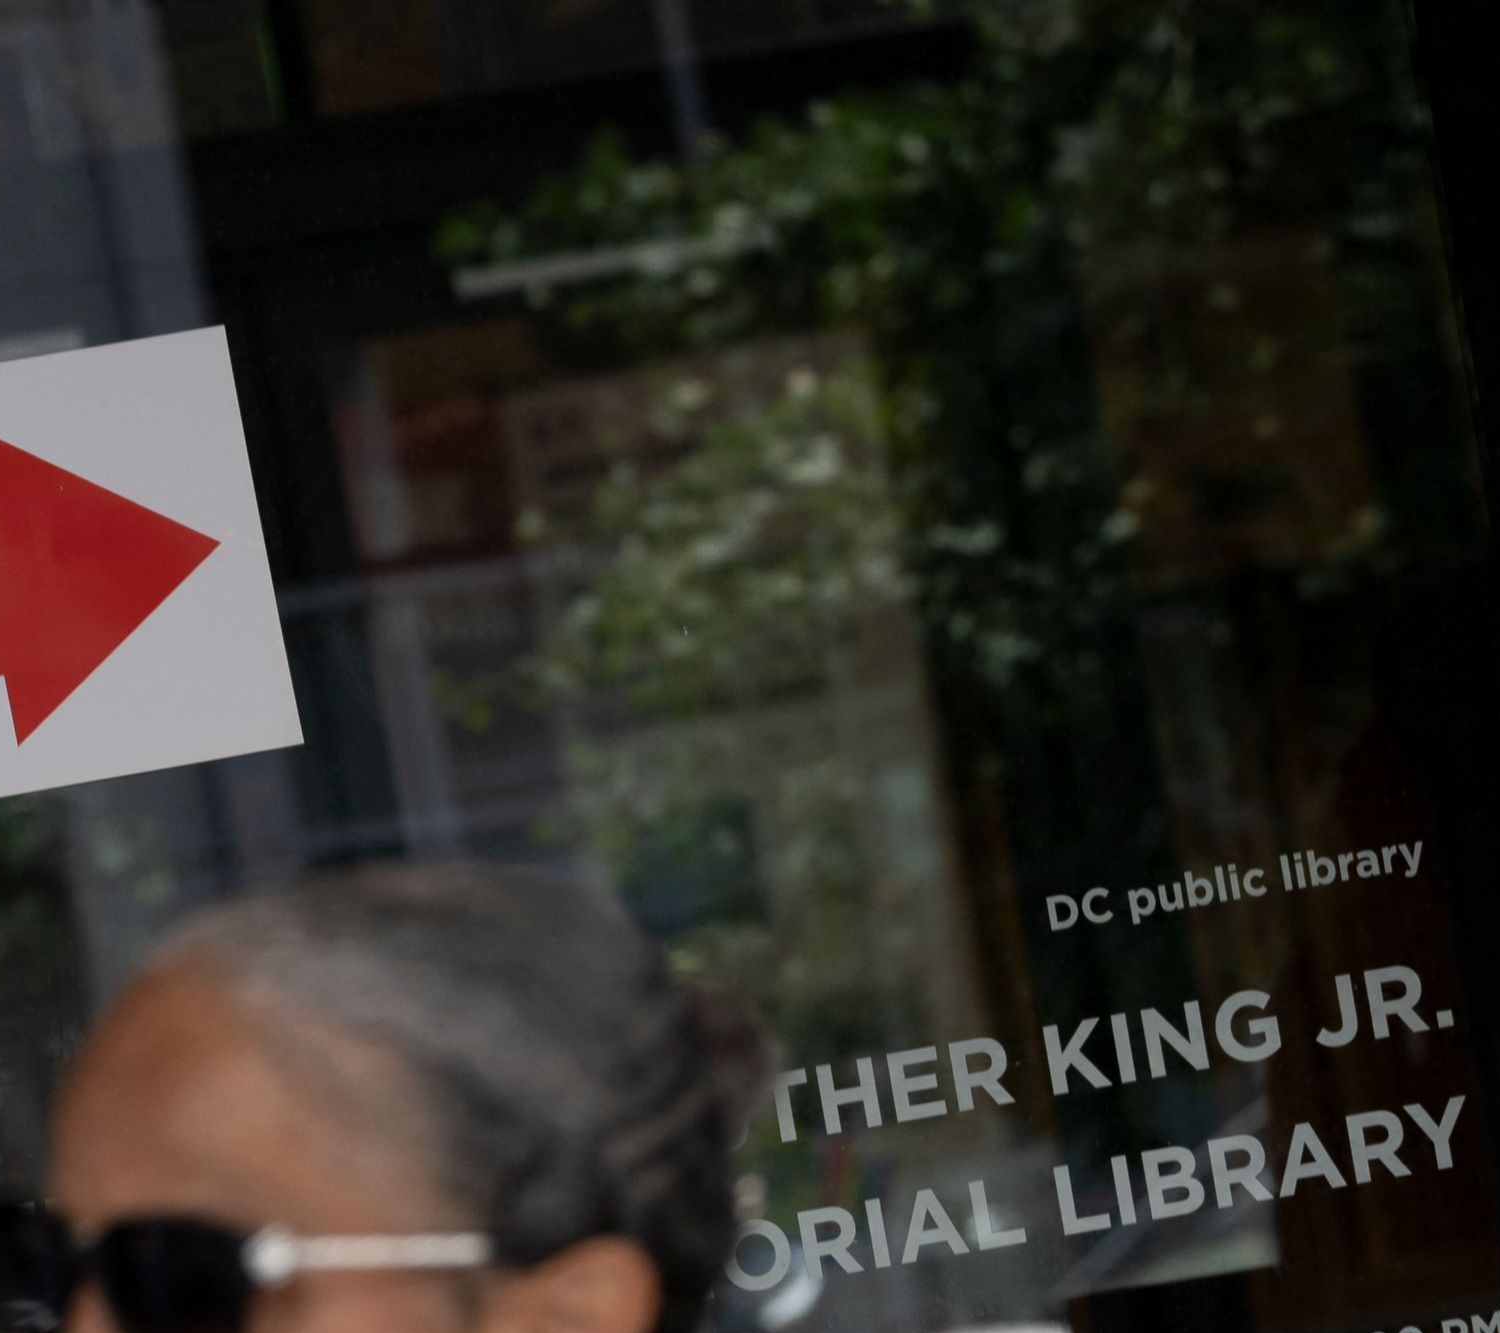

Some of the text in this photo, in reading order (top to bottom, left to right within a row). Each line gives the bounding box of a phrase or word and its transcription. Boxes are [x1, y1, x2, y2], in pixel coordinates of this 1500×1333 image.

[1045, 840, 1423, 932] DC public library
[770, 964, 1455, 1143] THER KING JR.
[724, 1094, 1466, 1292] ORIAL LIBRARY
